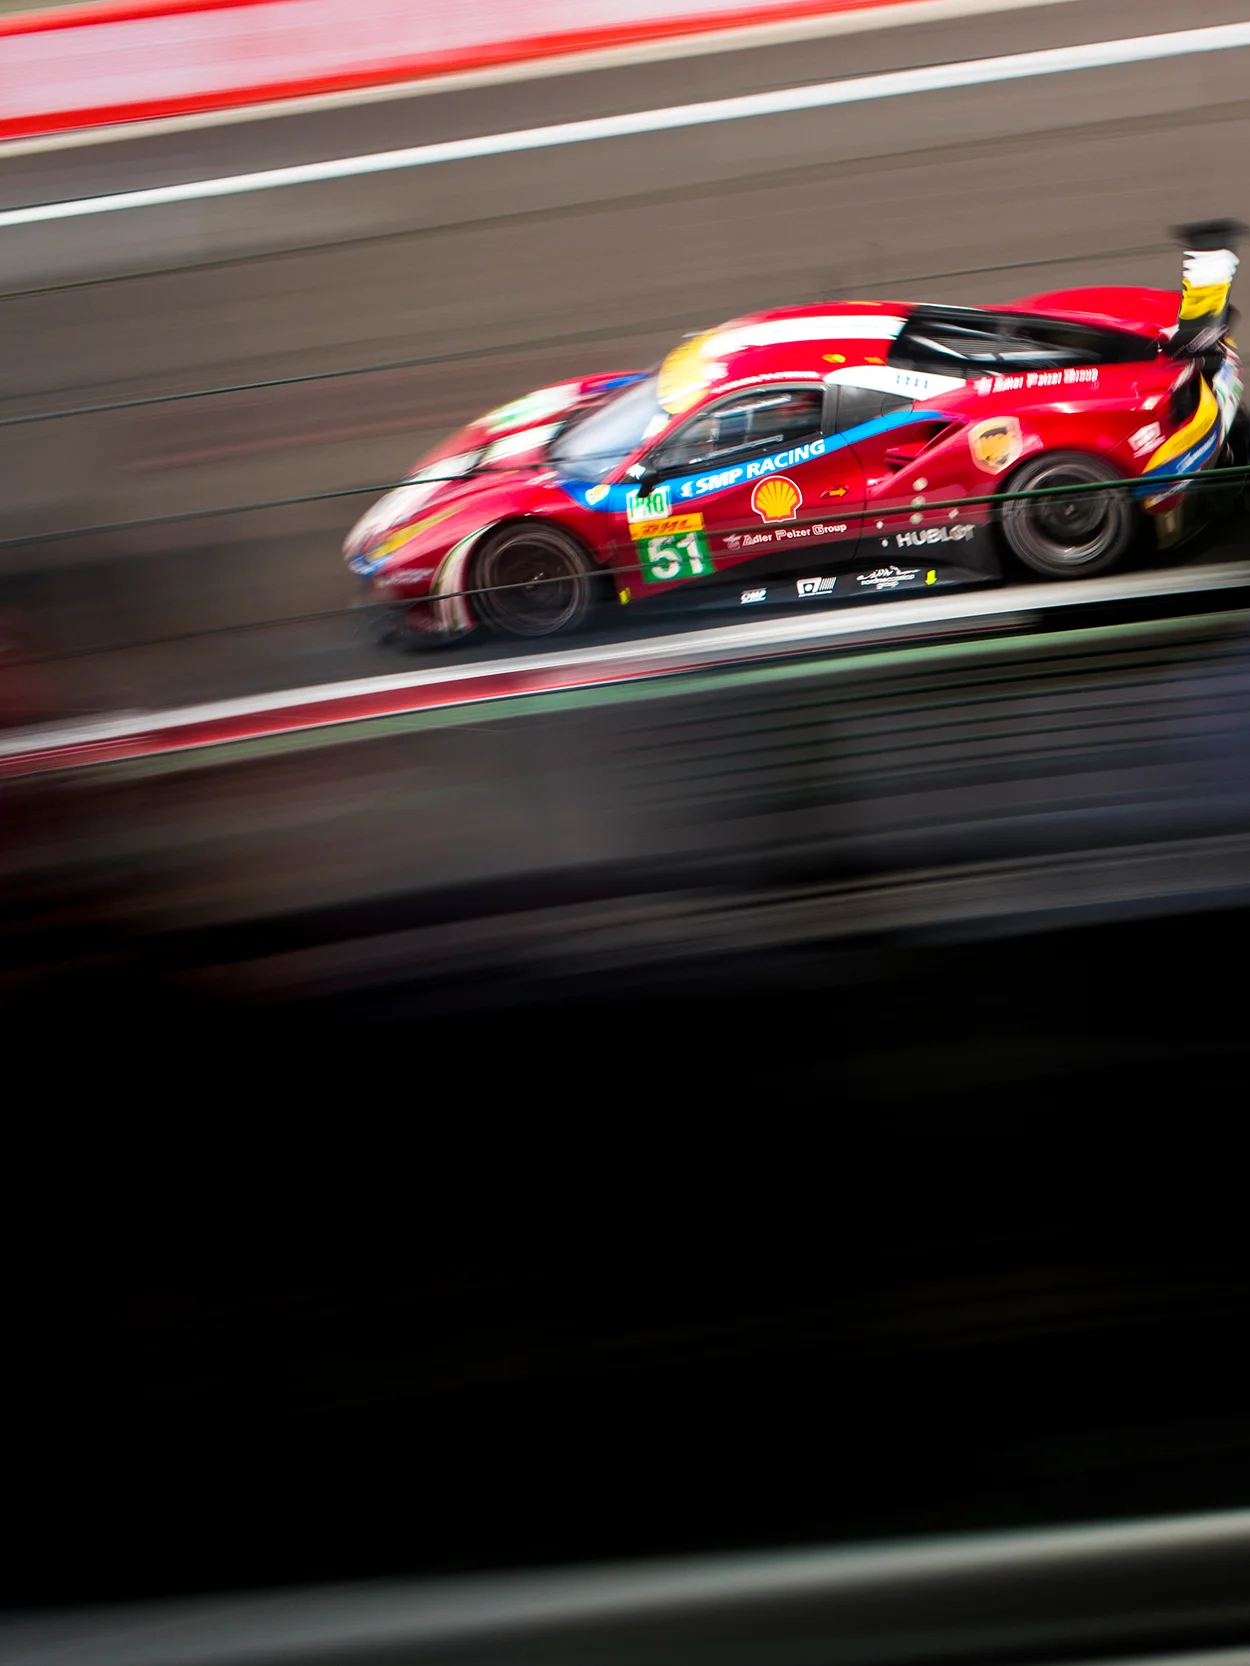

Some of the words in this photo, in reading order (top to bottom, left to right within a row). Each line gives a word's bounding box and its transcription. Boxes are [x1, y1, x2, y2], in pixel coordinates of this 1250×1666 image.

[695, 468, 743, 494] SMP
[746, 439, 826, 479] RACING
[640, 519, 693, 534] DHL
[742, 534, 772, 546] Adler
[775, 529, 811, 541] Pelzer
[812, 524, 847, 536] Group
[896, 524, 976, 547] HUBLOT
[648, 532, 704, 579] 51
